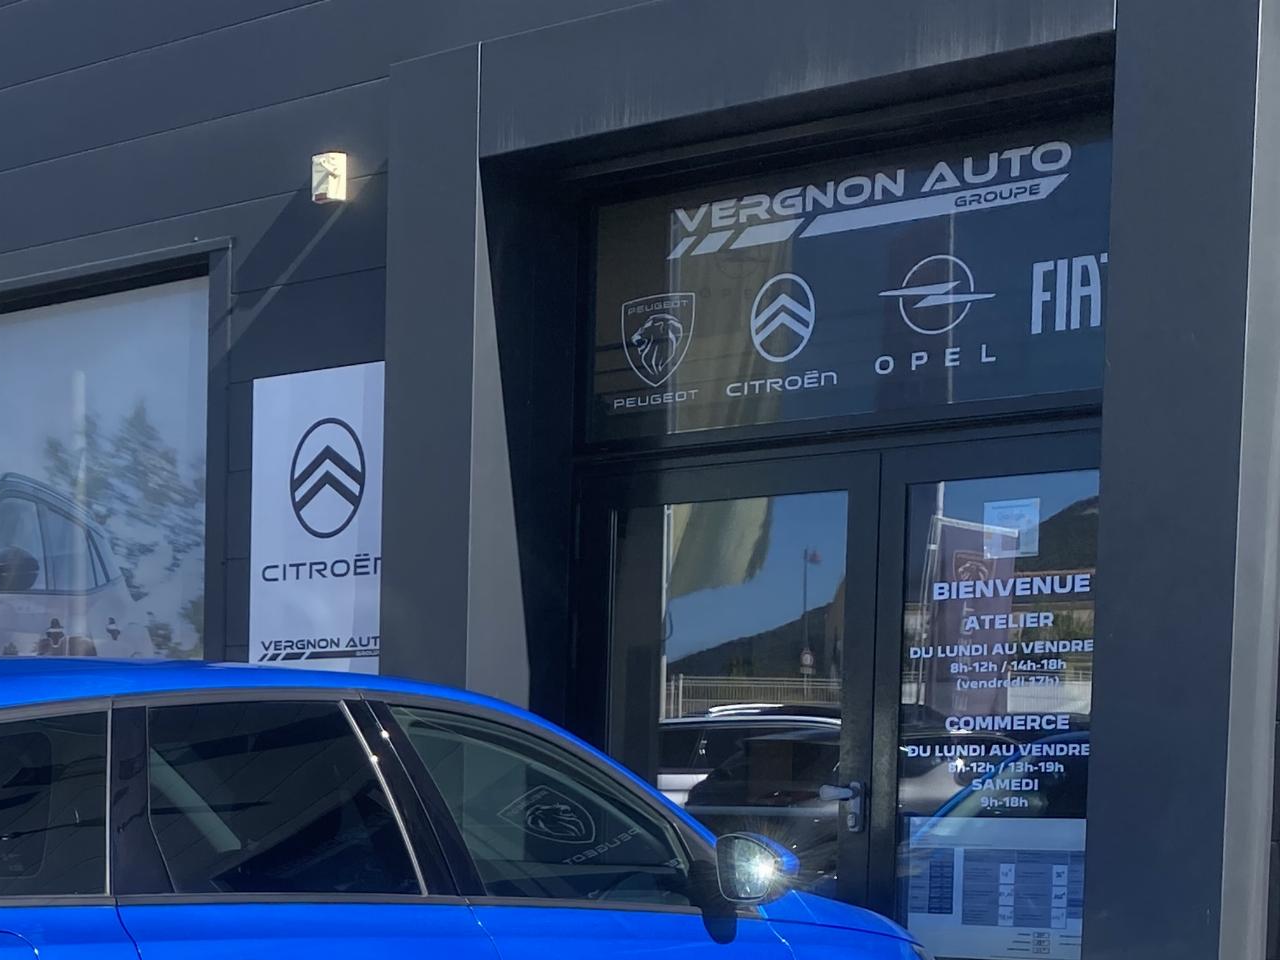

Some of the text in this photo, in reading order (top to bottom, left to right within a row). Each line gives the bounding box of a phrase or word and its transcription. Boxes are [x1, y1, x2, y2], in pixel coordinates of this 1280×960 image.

[675, 141, 1072, 233] VERGNON AUTO
[954, 183, 1041, 208] GROUPE
[1031, 252, 1108, 335] FIA
[627, 299, 689, 315] PEUGEOT
[875, 343, 997, 375] OPEL
[613, 389, 699, 409] PEUGEOT
[933, 573, 1091, 600] BIENVENUE
[965, 612, 1054, 631] ATELIER
[261, 635, 380, 652] VERGNON AUT
[910, 639, 1094, 659] DU LUNDI AU VENDRE
[950, 661, 998, 674] 8h-12h
[1010, 658, 1067, 672] 14h-18h
[945, 714, 1070, 731] COMMERCE
[907, 743, 1090, 757] DU LUNDI AU VENDRE
[948, 761, 995, 773] 8h-12h
[1009, 761, 1064, 773] 13h-19h
[972, 777, 1039, 791] SAMEDI
[980, 796, 1029, 808] 9h-18h
